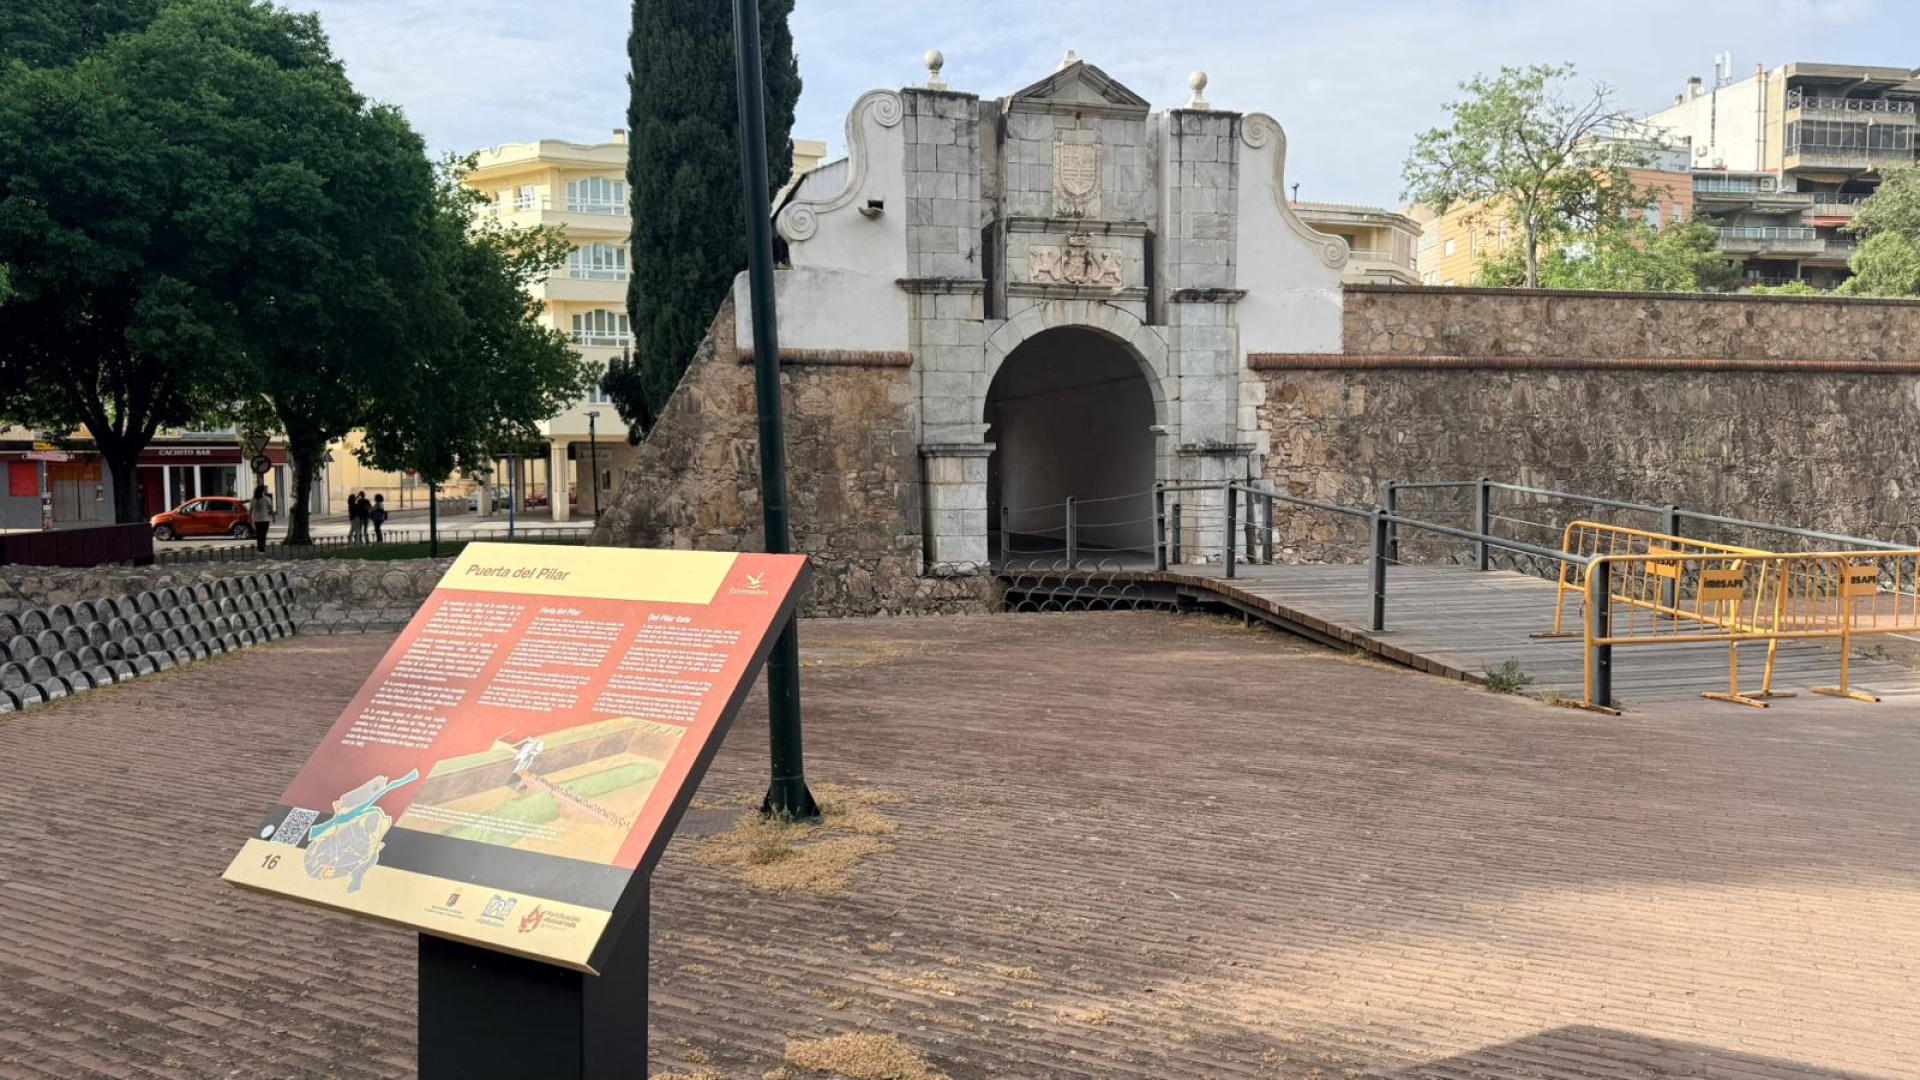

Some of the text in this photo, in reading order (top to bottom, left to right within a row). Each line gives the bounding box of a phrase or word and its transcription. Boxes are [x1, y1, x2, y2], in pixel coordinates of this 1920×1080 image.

[466, 564, 571, 581] Puerta del Pilar
[1840, 574, 1876, 584] iesAPI
[261, 854, 281, 870] 16
